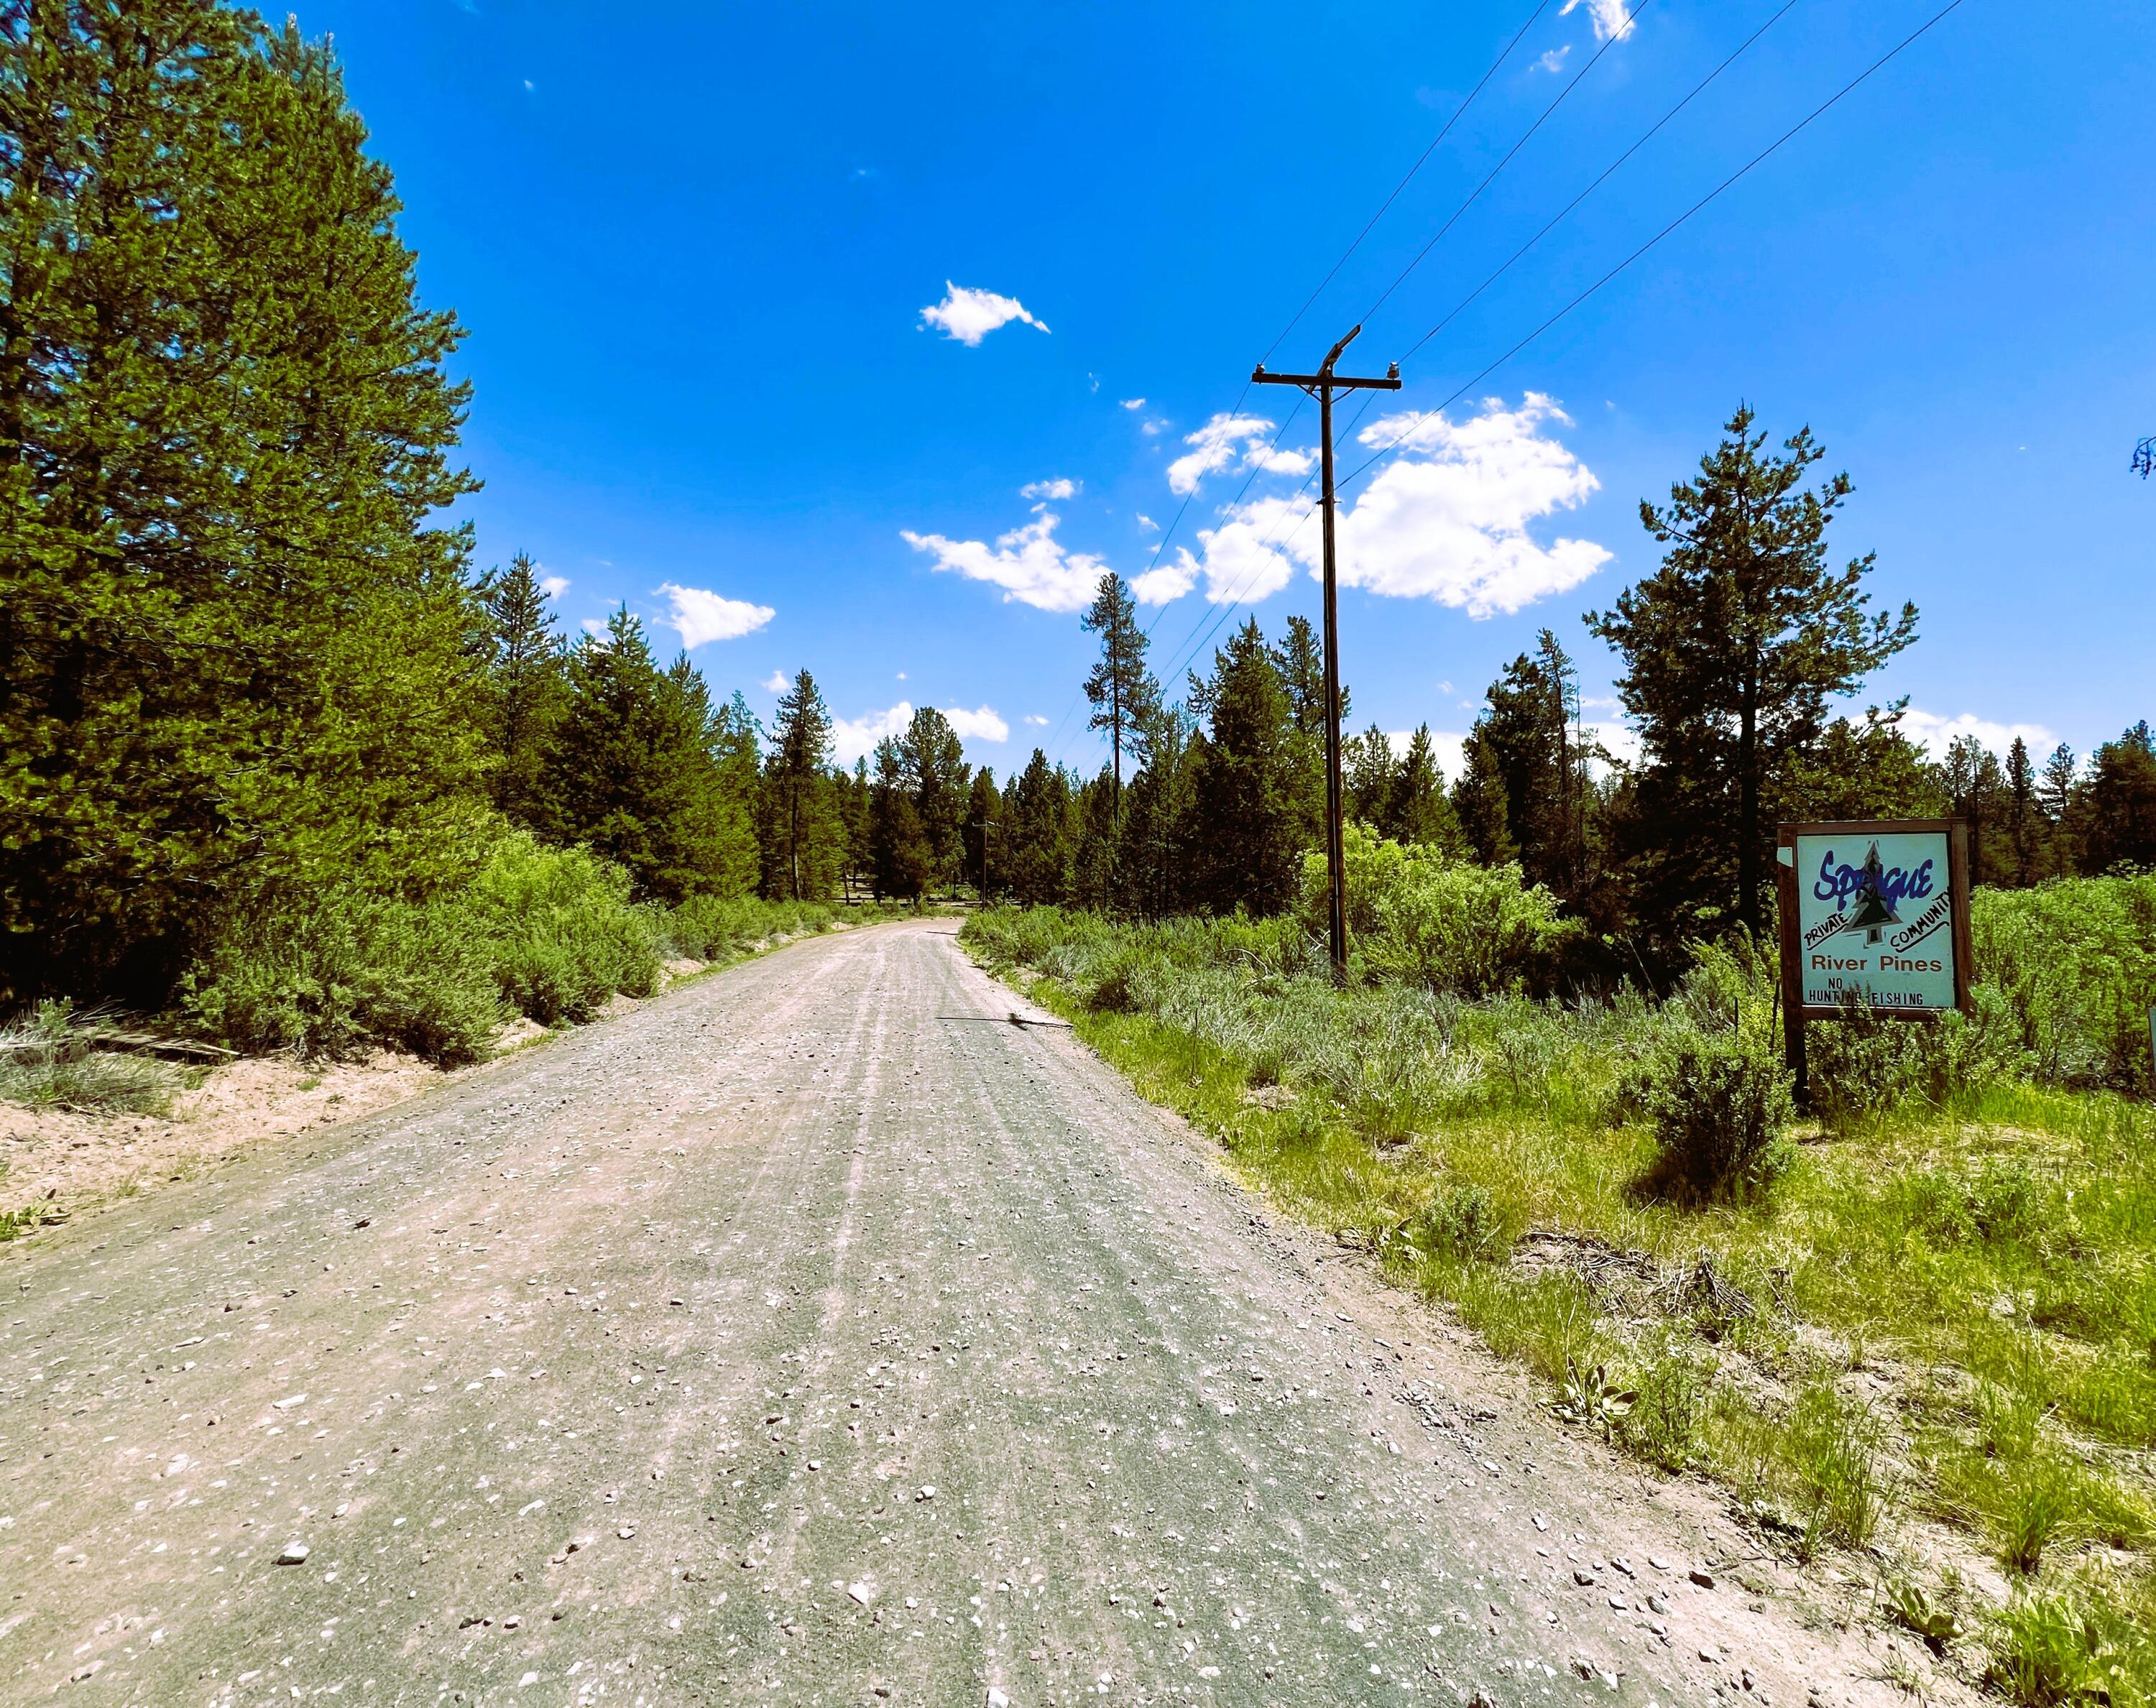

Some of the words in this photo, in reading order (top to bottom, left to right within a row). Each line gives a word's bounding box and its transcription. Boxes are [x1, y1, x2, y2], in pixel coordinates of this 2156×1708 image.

[1890, 886, 1950, 948] COMMUNITY
[1804, 912, 1849, 946] PRIVATE
[1812, 954, 1867, 971] River
[1880, 956, 1943, 972] Pines
[1828, 977, 1843, 989] NO
[1871, 992, 1924, 1005] FISHING
